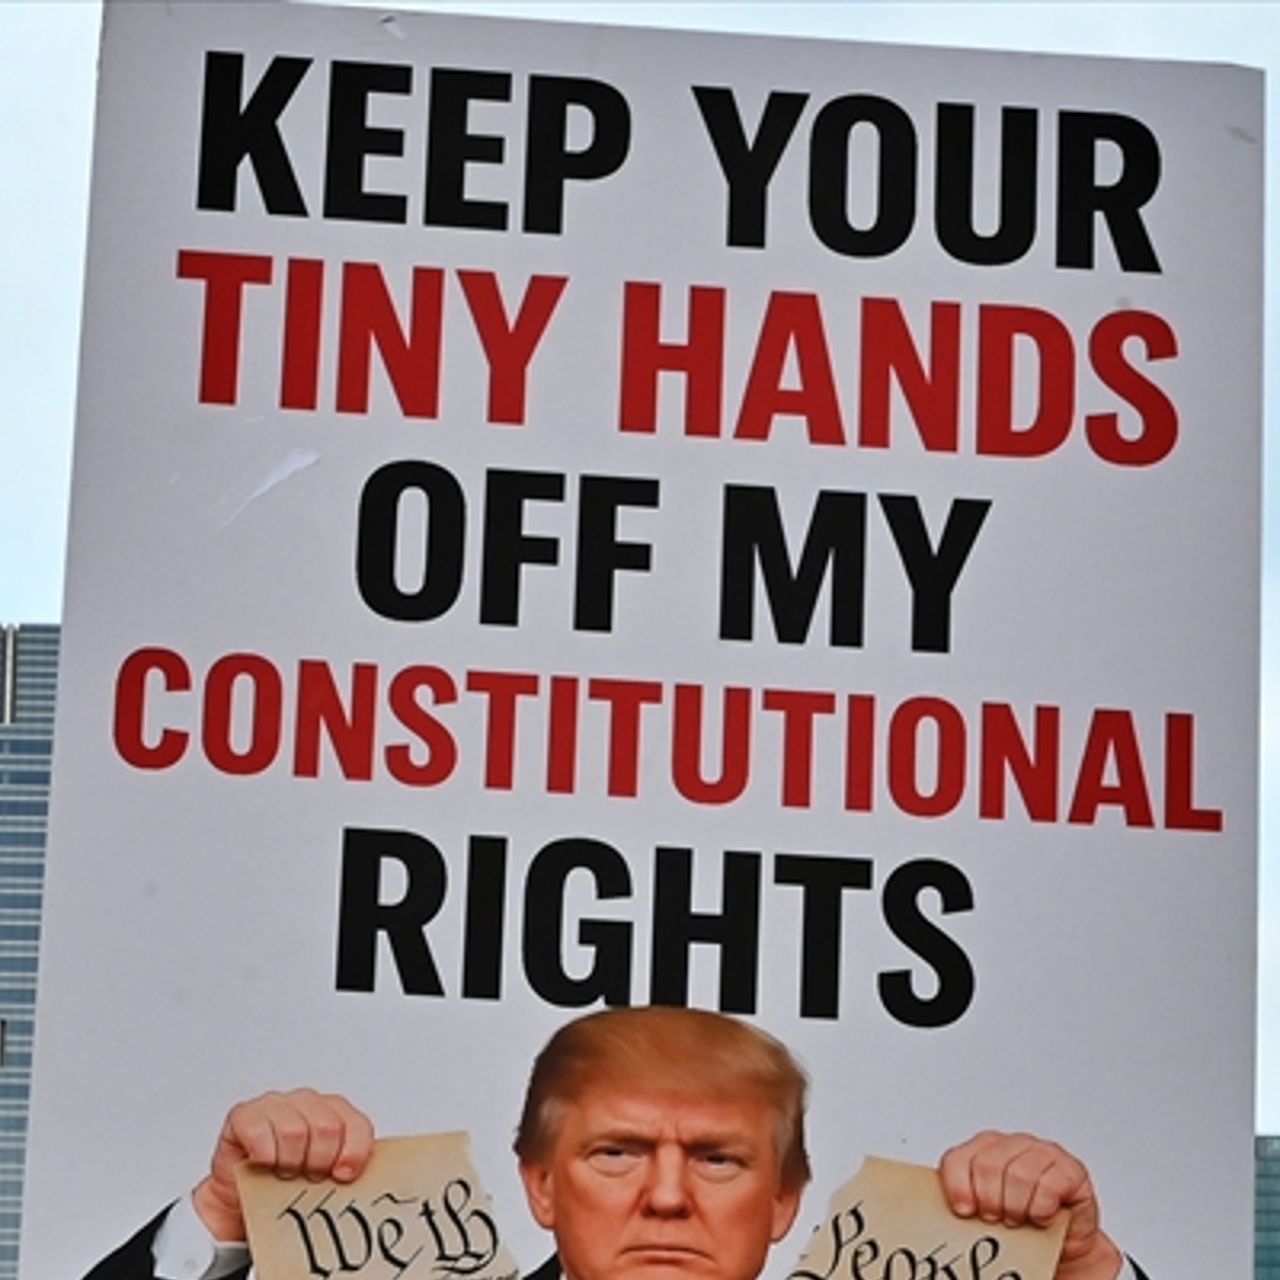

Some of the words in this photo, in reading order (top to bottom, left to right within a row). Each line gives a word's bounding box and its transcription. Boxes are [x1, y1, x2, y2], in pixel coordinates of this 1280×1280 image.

[197, 51, 631, 236] KEEP
[691, 86, 1162, 275] YOUR
[179, 251, 566, 425] TINY
[620, 282, 1178, 467] HANDS
[356, 460, 659, 634] OFF
[720, 484, 992, 654] MY
[115, 648, 1221, 832] CONSTITUTIONAL
[336, 828, 974, 1029] RIGHTS
